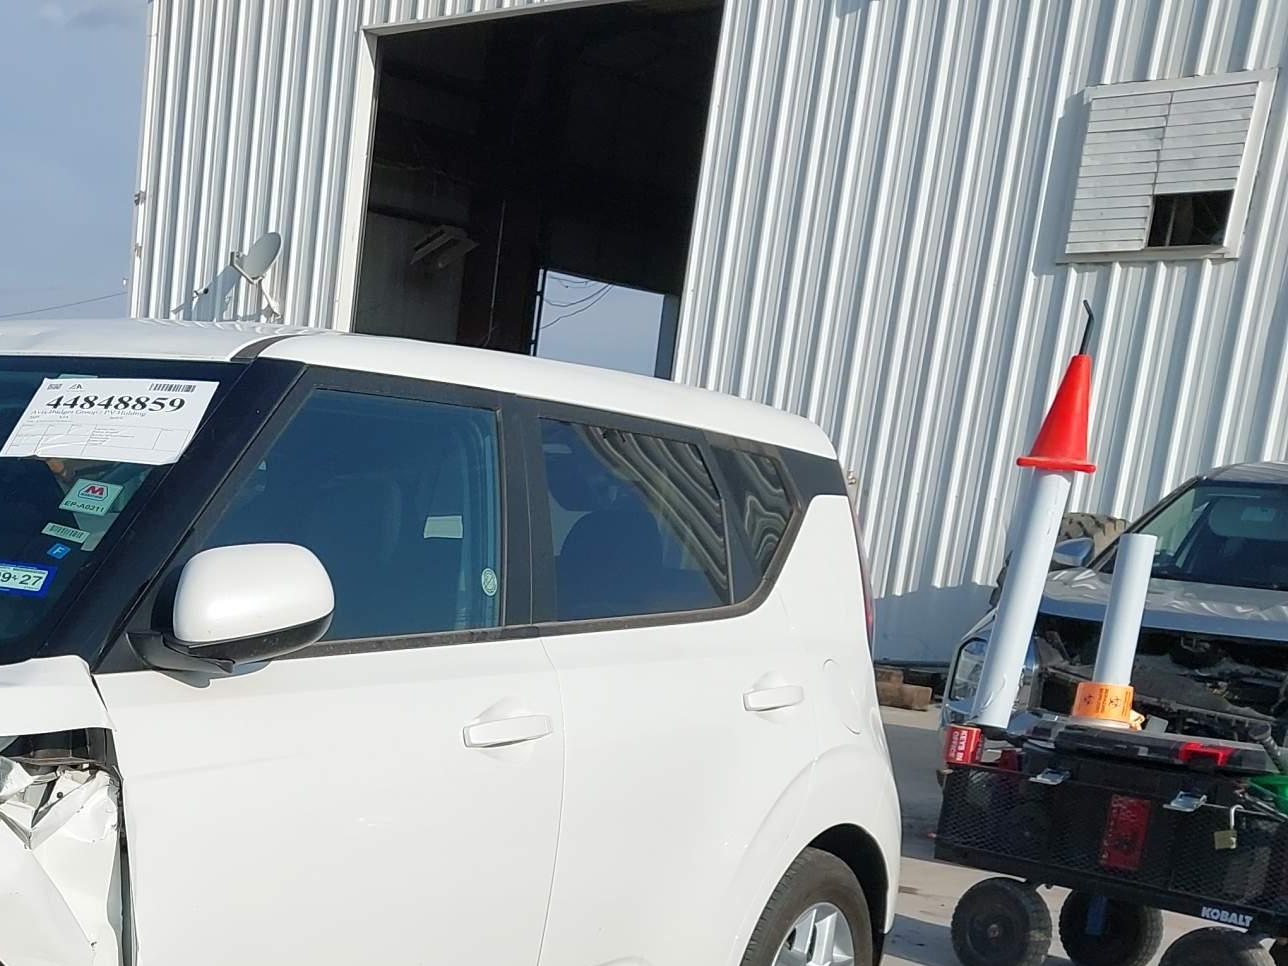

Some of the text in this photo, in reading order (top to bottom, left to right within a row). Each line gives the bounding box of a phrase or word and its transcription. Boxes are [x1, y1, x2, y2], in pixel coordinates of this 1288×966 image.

[46, 395, 186, 413] 44848859
[53, 547, 65, 556] F
[957, 730, 969, 751] KEYS
[1201, 906, 1254, 927] KOBALT
